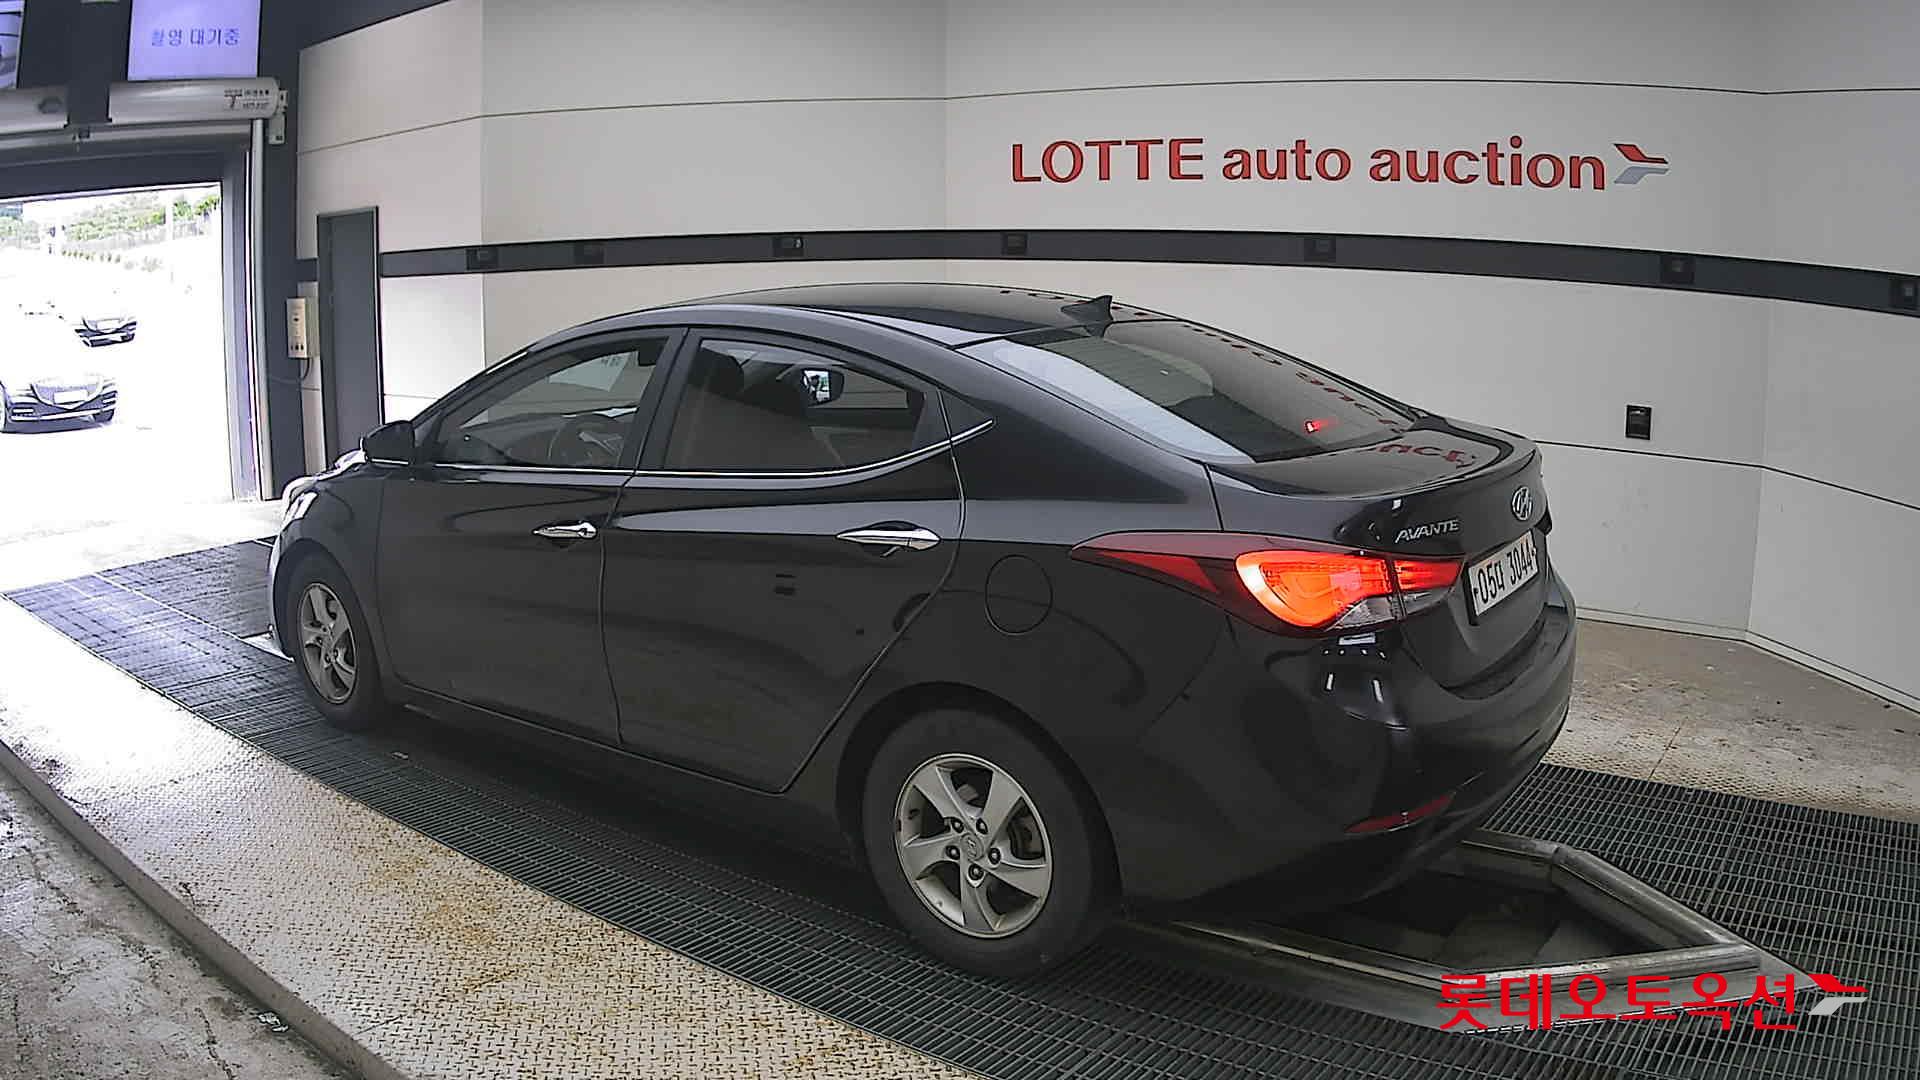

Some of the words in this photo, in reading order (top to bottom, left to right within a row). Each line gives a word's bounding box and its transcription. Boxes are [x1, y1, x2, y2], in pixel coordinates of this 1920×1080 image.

[190, 28, 240, 47] 대기중
[1011, 138, 1204, 184] LOTTE
[1222, 139, 1352, 182] auto
[1369, 135, 1606, 191] auction
[1394, 519, 1460, 544] AVANTE
[1506, 538, 1534, 585] 3044
